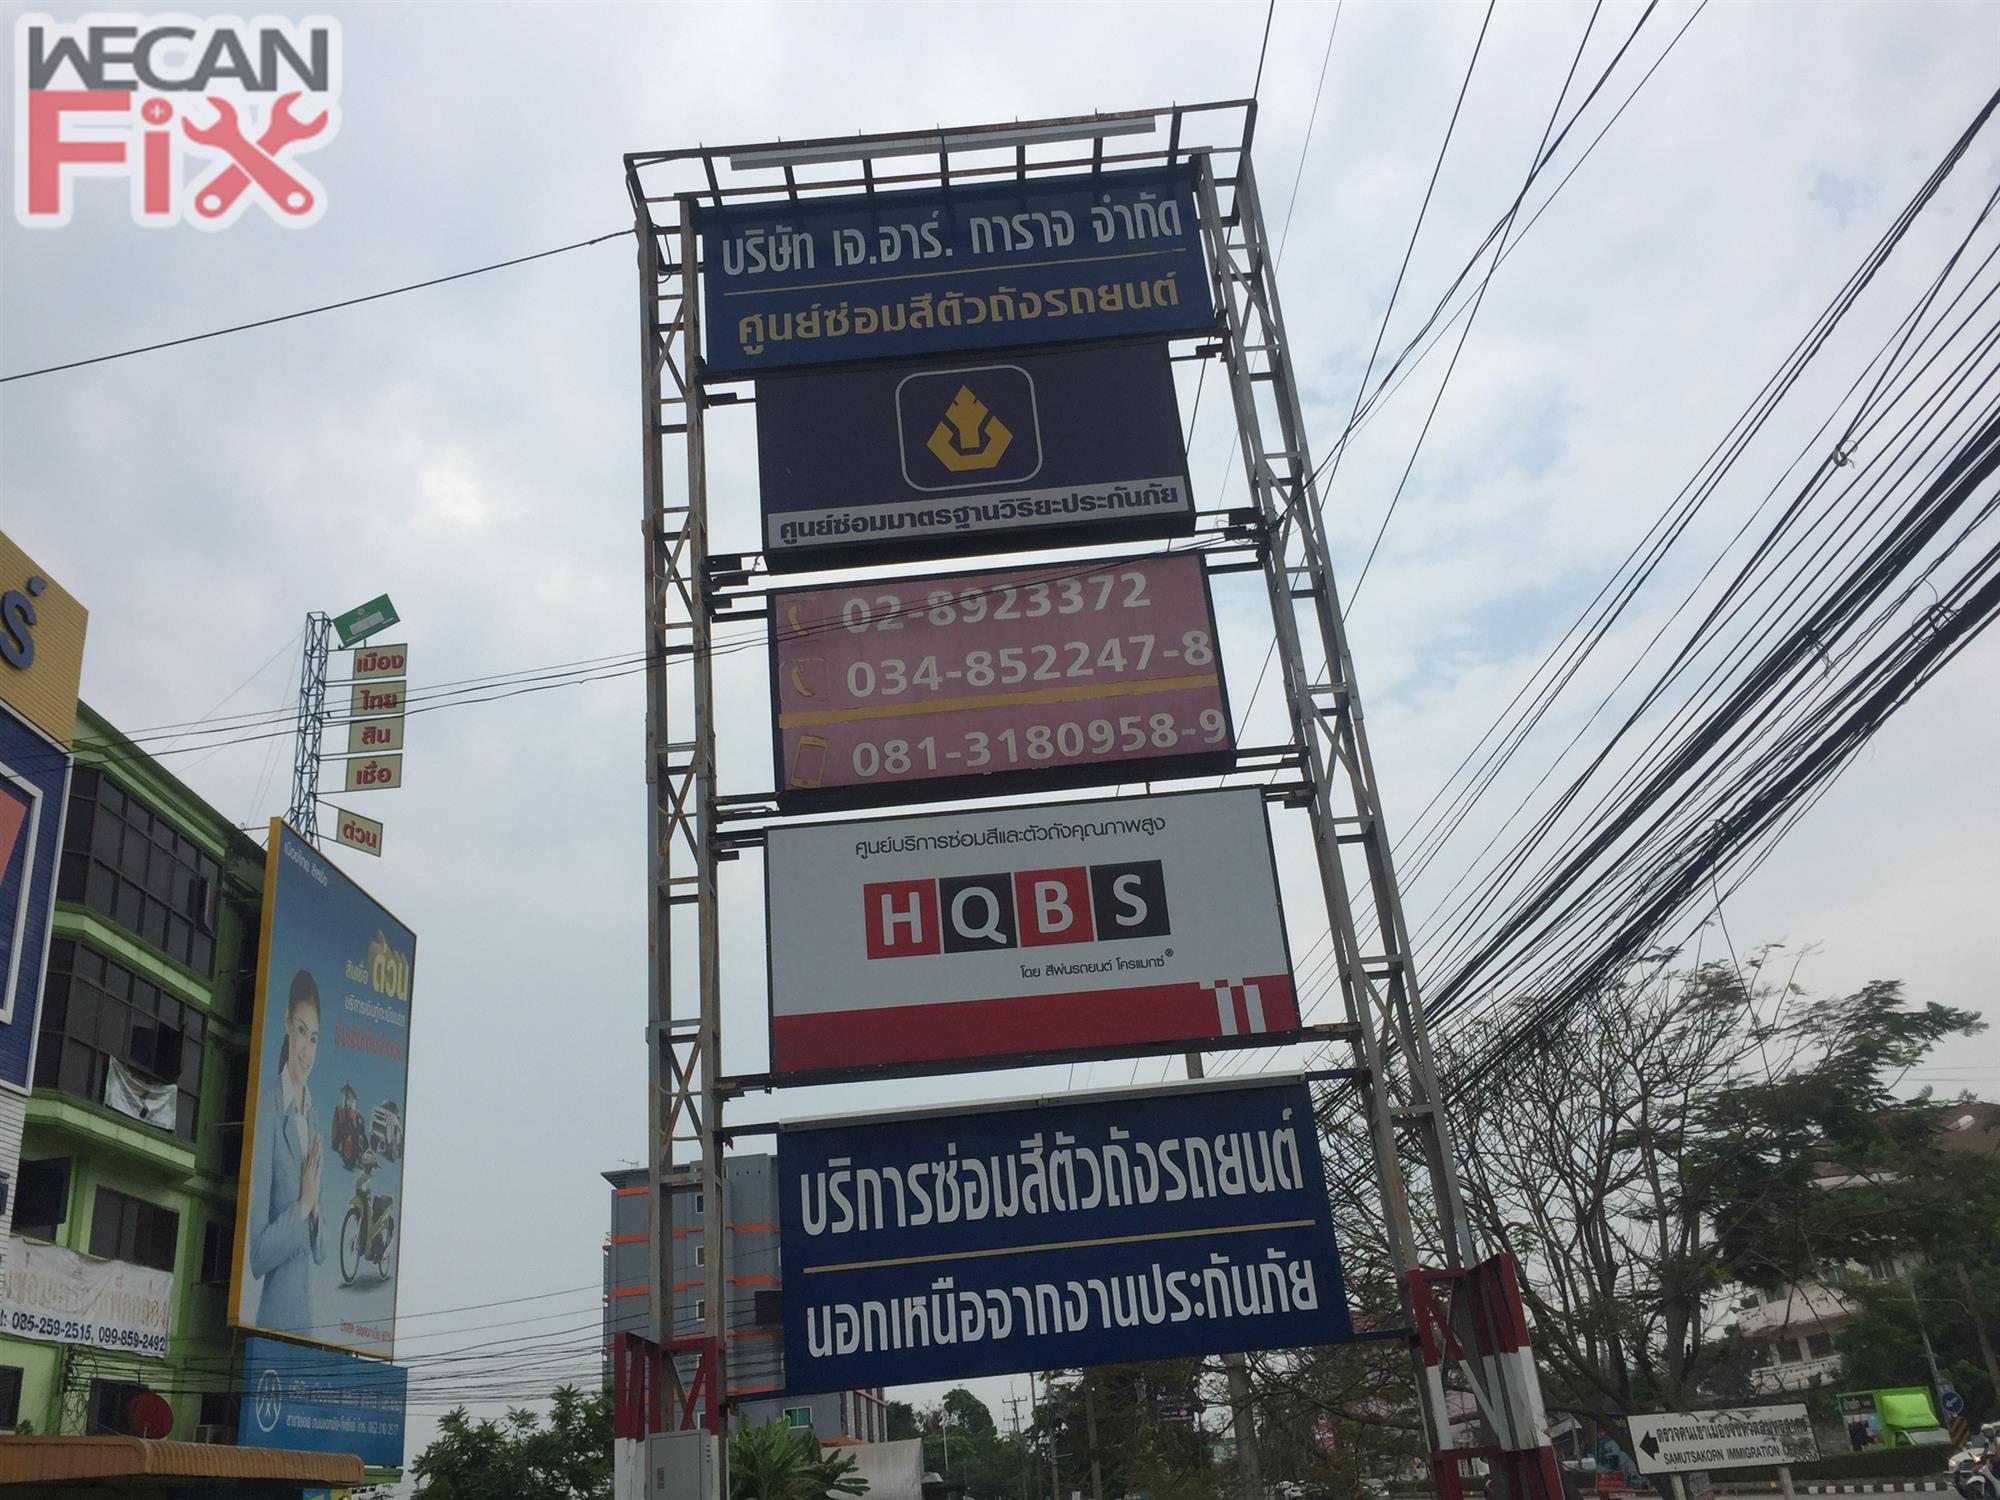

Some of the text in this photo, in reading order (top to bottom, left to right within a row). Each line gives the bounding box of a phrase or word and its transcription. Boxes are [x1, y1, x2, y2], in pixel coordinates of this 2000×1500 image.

[722, 191, 1182, 276] บริษัท เจ.อาร์. การาจ จำกัด
[738, 271, 1179, 355] ศูนย์ซ่อมสีตัวถังรถยนต์
[780, 482, 1178, 545] ศูนย์ซ่อมมาตรฐานวิริยะประกันภัย
[842, 571, 1151, 634] 02-8923372
[356, 652, 404, 673] เมือง
[847, 630, 1213, 698] 034-852247-8
[360, 689, 398, 710] ไทย
[361, 726, 391, 745] สิน
[852, 708, 1227, 777] 081-3180958-9
[342, 821, 377, 848] ด่วน
[855, 816, 1166, 860] ศูนย์บริการซ่อมสีและตัวถังคุณภาพสูง
[881, 873, 1149, 946] HQBS
[1020, 964, 1041, 978] โดย
[1045, 959, 1113, 977] สีพ่นรถยนต์
[801, 1107, 1304, 1236] บริการซ่อมสีตัวถังรถยนต์
[806, 1247, 1318, 1358] นอกเหนือจากงานประกันภัย
[99, 1326, 165, 1351] 099-859-2492
[1663, 1449, 1725, 1465] SAMUTSAKORN
[1727, 1445, 1781, 1461] IMMIGRATION
